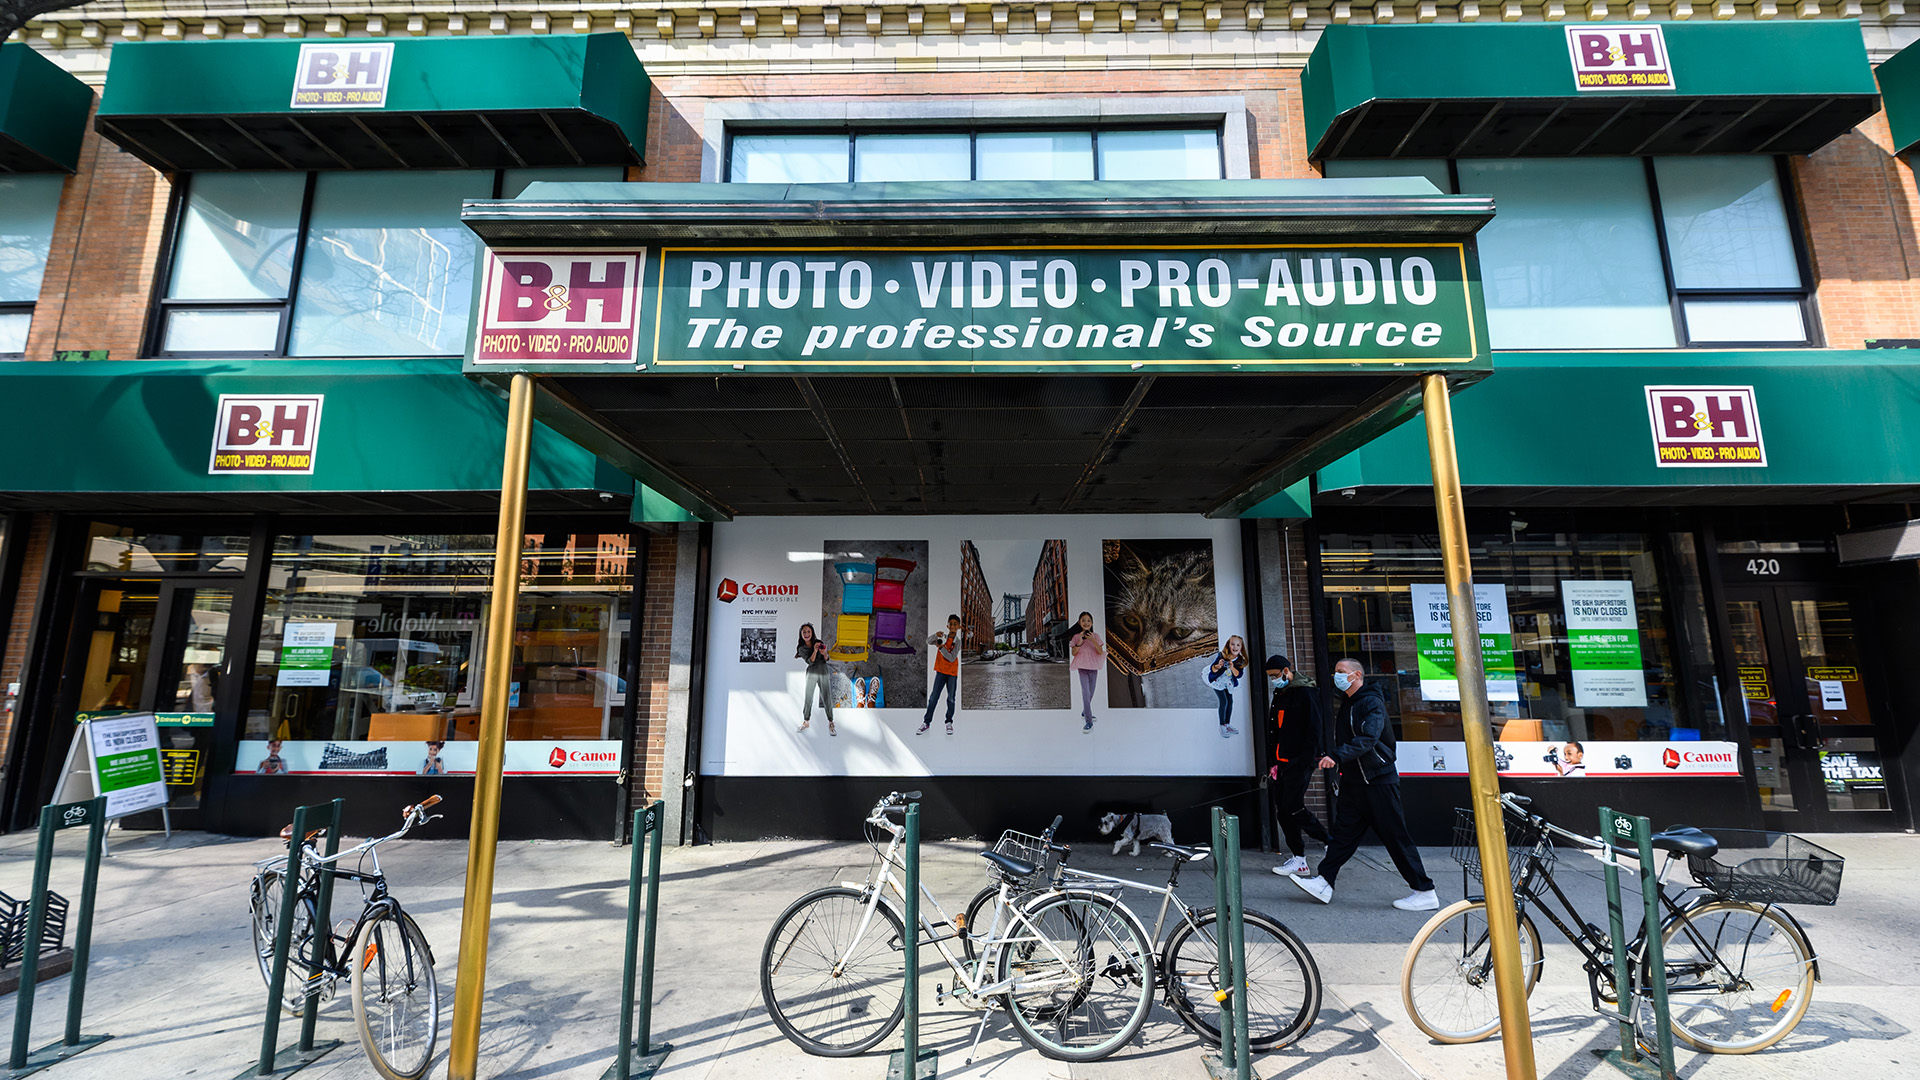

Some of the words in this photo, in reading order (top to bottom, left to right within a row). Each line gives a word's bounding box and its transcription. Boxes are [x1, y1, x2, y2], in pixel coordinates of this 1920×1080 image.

[1579, 33, 1657, 67] B&H
[306, 51, 382, 85] B&H
[1579, 74, 1604, 85] PHOTO
[1606, 74, 1628, 85] VIDEO
[1631, 73, 1647, 84] PRO
[1647, 73, 1669, 84] AUDIO
[296, 91, 320, 103] PHOTO
[323, 91, 343, 102] VIDEO
[346, 91, 361, 102] PRO
[361, 91, 382, 102] AUDIO
[688, 260, 873, 309] PHOTO
[911, 258, 1078, 309] VIDEO
[1119, 256, 1437, 308] PRO-AUDIO
[497, 261, 627, 323] B&H
[686, 318, 784, 349] The
[801, 316, 1215, 356] professional's
[1240, 315, 1443, 348] Source
[482, 334, 521, 353] PHOTO
[528, 334, 561, 353] VIDEO
[569, 335, 593, 353] PRO
[594, 335, 629, 353] AUDIO
[1659, 396, 1749, 438] B&H
[225, 405, 309, 446] B&H
[1660, 446, 1688, 460] PHOTO
[1690, 446, 1715, 460] VIDEO
[1718, 446, 1736, 460] PRO
[1736, 446, 1760, 460] AUDIO
[215, 454, 241, 467] PHOTO
[244, 454, 267, 467] VIDEO
[270, 454, 287, 467] PRO
[287, 454, 310, 467] AUDIO
[1746, 558, 1780, 575] 420
[742, 582, 799, 596] Canon
[1571, 599, 1581, 607] THE
[1594, 599, 1627, 607] SUPERSTORE
[1430, 612, 1438, 621] IS
[1440, 612, 1451, 621] NO
[1573, 607, 1581, 616] IS
[1582, 607, 1598, 616] NOW
[1600, 607, 1628, 616] CLOSED
[1433, 638, 1445, 647] WE
[1481, 638, 1495, 647] FOR
[569, 751, 616, 762] Canon
[1683, 751, 1732, 763] Canon
[1820, 756, 1859, 767] SAVE
[1821, 767, 1853, 778] THE
[1852, 766, 1883, 778] TAX
